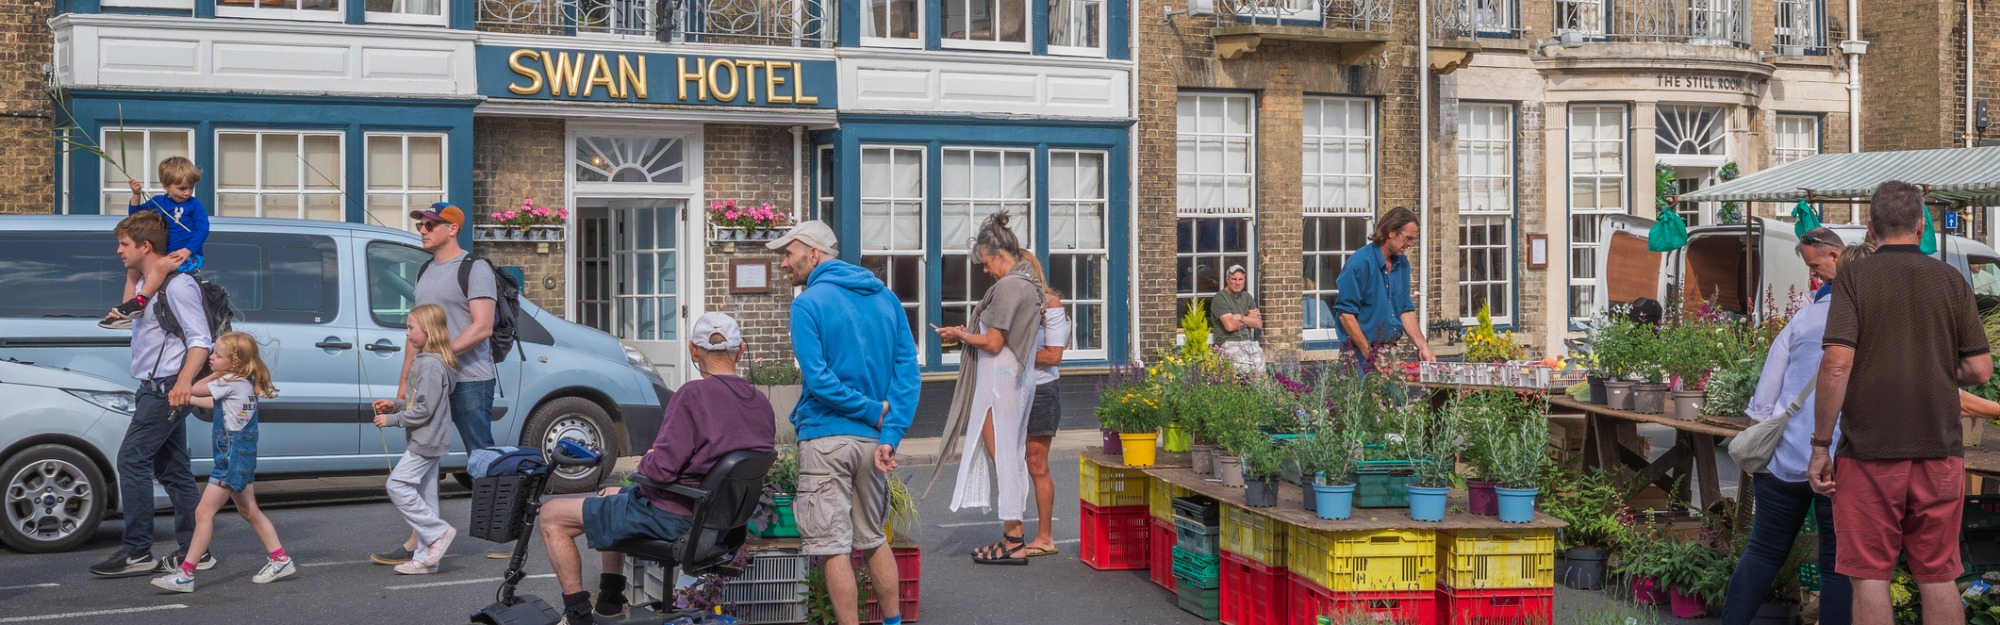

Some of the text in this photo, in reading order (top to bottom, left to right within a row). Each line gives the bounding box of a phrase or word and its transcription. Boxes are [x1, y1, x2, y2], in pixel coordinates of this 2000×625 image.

[508, 48, 818, 105] SWAN HOTEL
[1657, 76, 1741, 90] THE STILL ROOM
